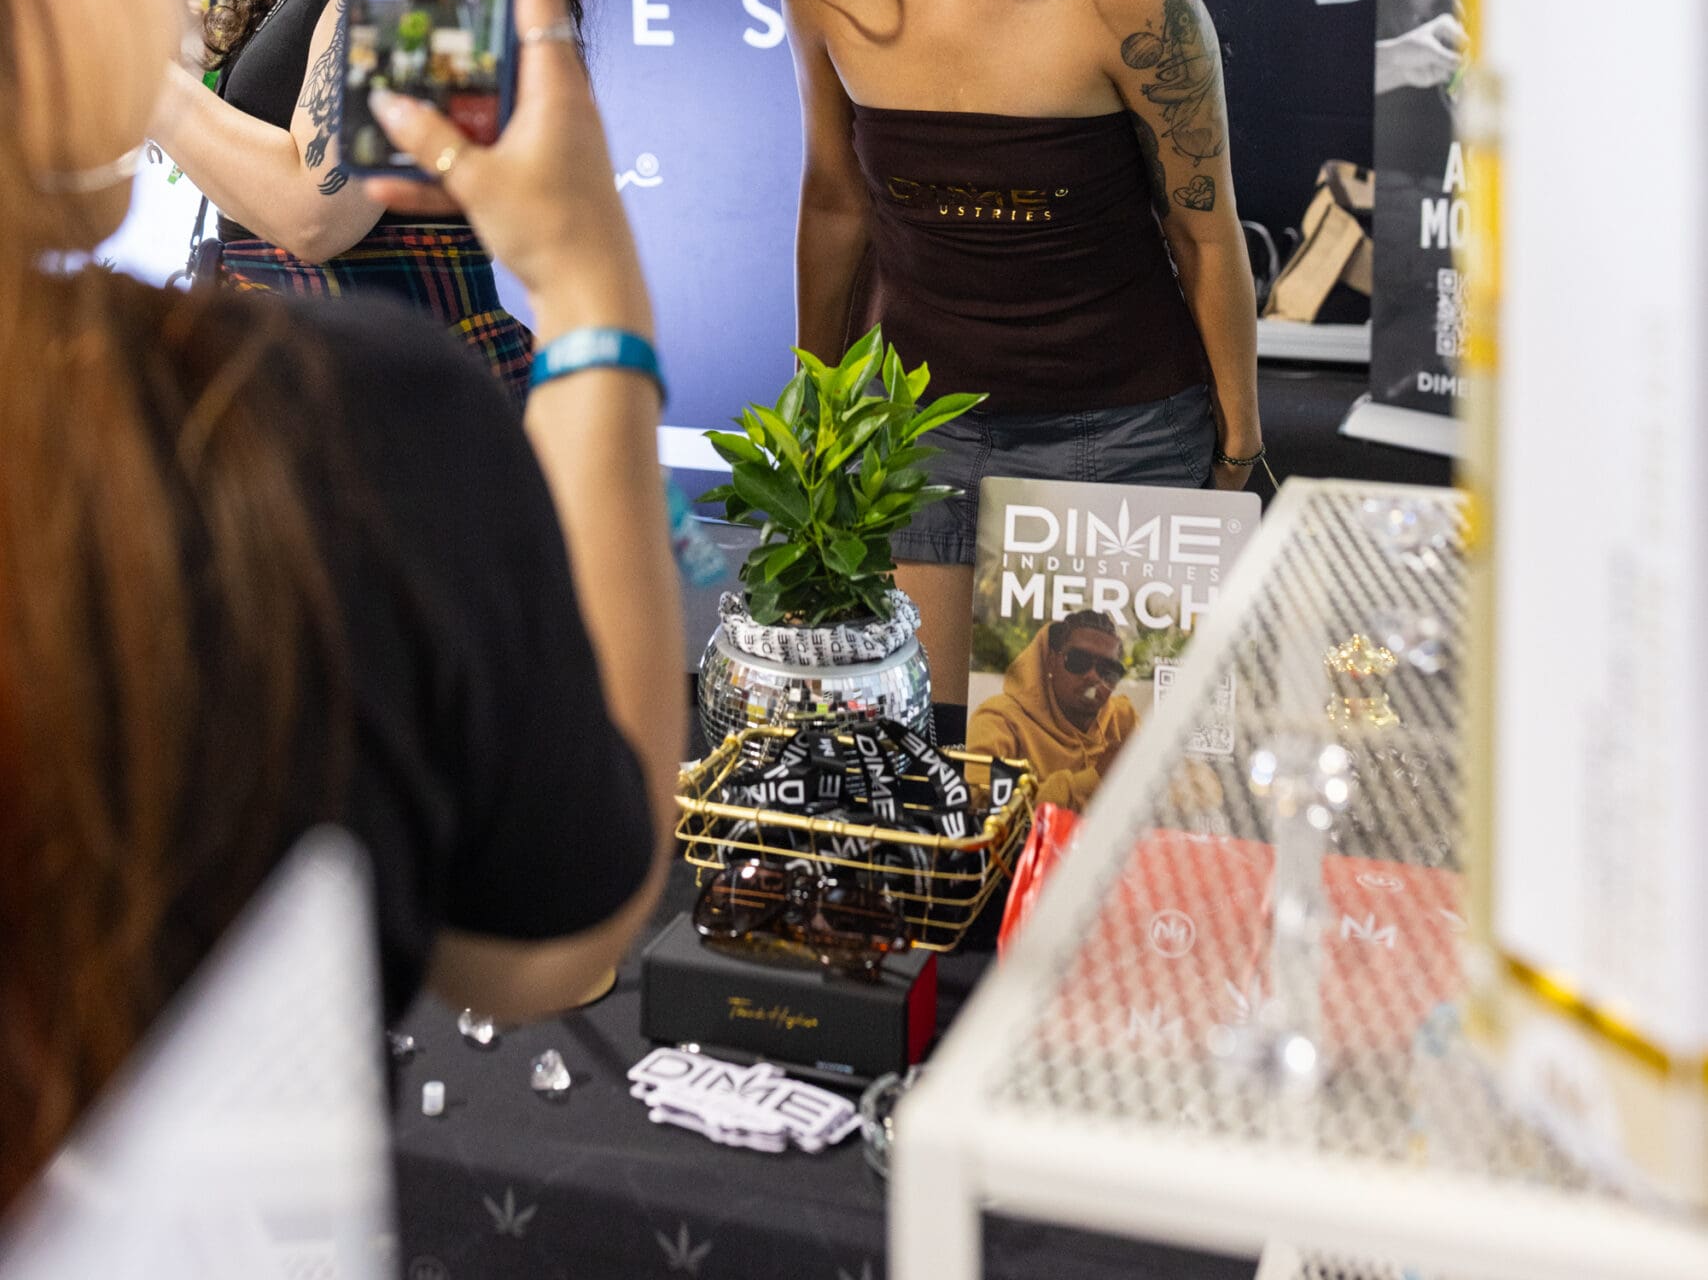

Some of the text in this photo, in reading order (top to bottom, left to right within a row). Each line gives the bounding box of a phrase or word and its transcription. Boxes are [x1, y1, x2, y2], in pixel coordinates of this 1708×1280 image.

[1002, 552, 1220, 582] INDUSTRIES
[1000, 571, 1219, 631] MERCH
[855, 732, 898, 822] DIME
